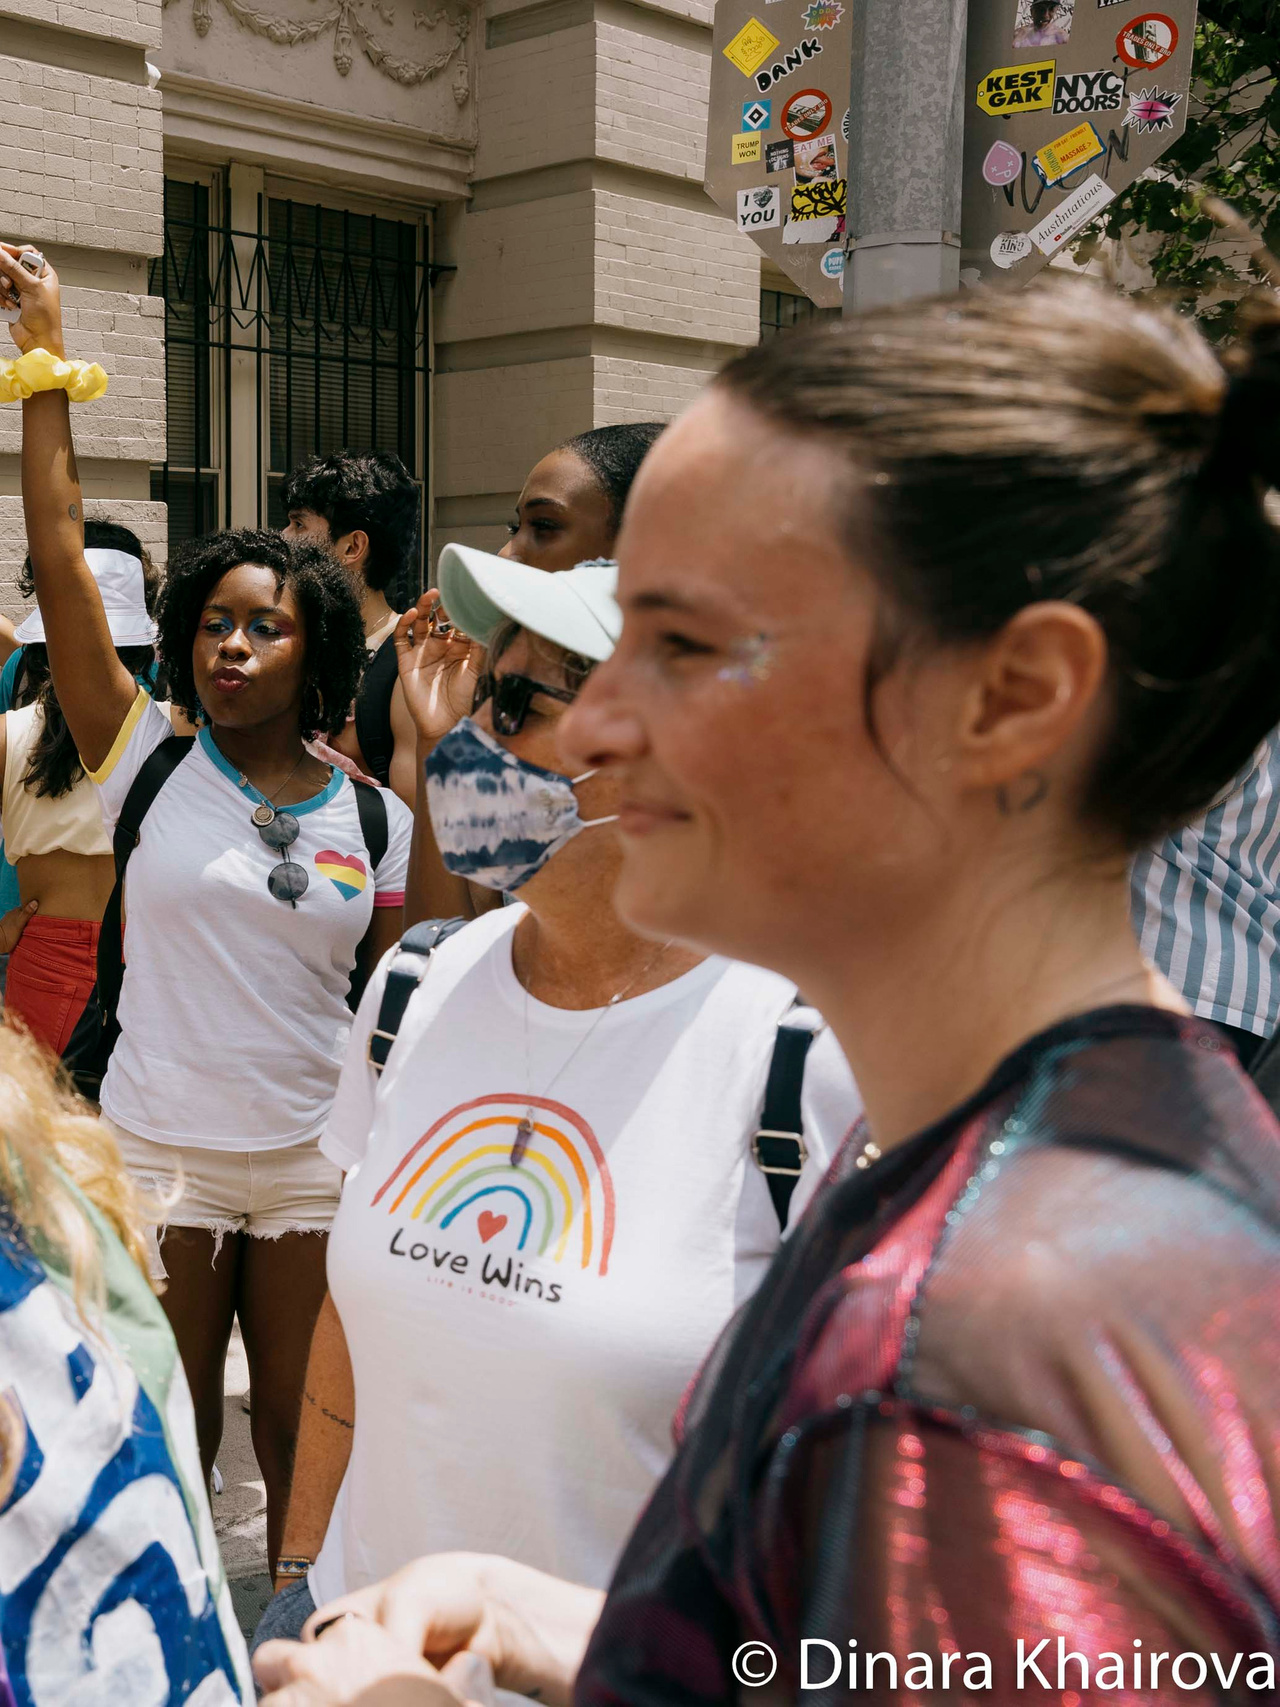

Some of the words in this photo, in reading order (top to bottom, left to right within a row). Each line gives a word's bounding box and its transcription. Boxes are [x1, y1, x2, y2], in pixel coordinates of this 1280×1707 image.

[1122, 31, 1144, 46] TRADES
[1144, 39, 1160, 51] ONLY
[1160, 48, 1172, 57] BRO
[756, 38, 822, 91] DANK
[986, 68, 1053, 93] KEST
[1055, 71, 1122, 98] NYC
[988, 86, 1043, 108] GAK
[1052, 93, 1121, 115] DOORS
[784, 115, 804, 132] TRADES
[803, 105, 818, 119] ONLY
[736, 140, 759, 150] TRUMP
[739, 150, 757, 158] WON
[793, 141, 813, 154] EAT
[817, 135, 833, 147] ME
[1060, 143, 1087, 164] MASSAGE
[1043, 148, 1063, 176] LOOKING
[744, 194, 749, 207] I
[740, 208, 775, 226] YOU
[1038, 181, 1103, 244] Austintatious
[389, 1227, 468, 1274] Love
[481, 1253, 562, 1303] Wins
